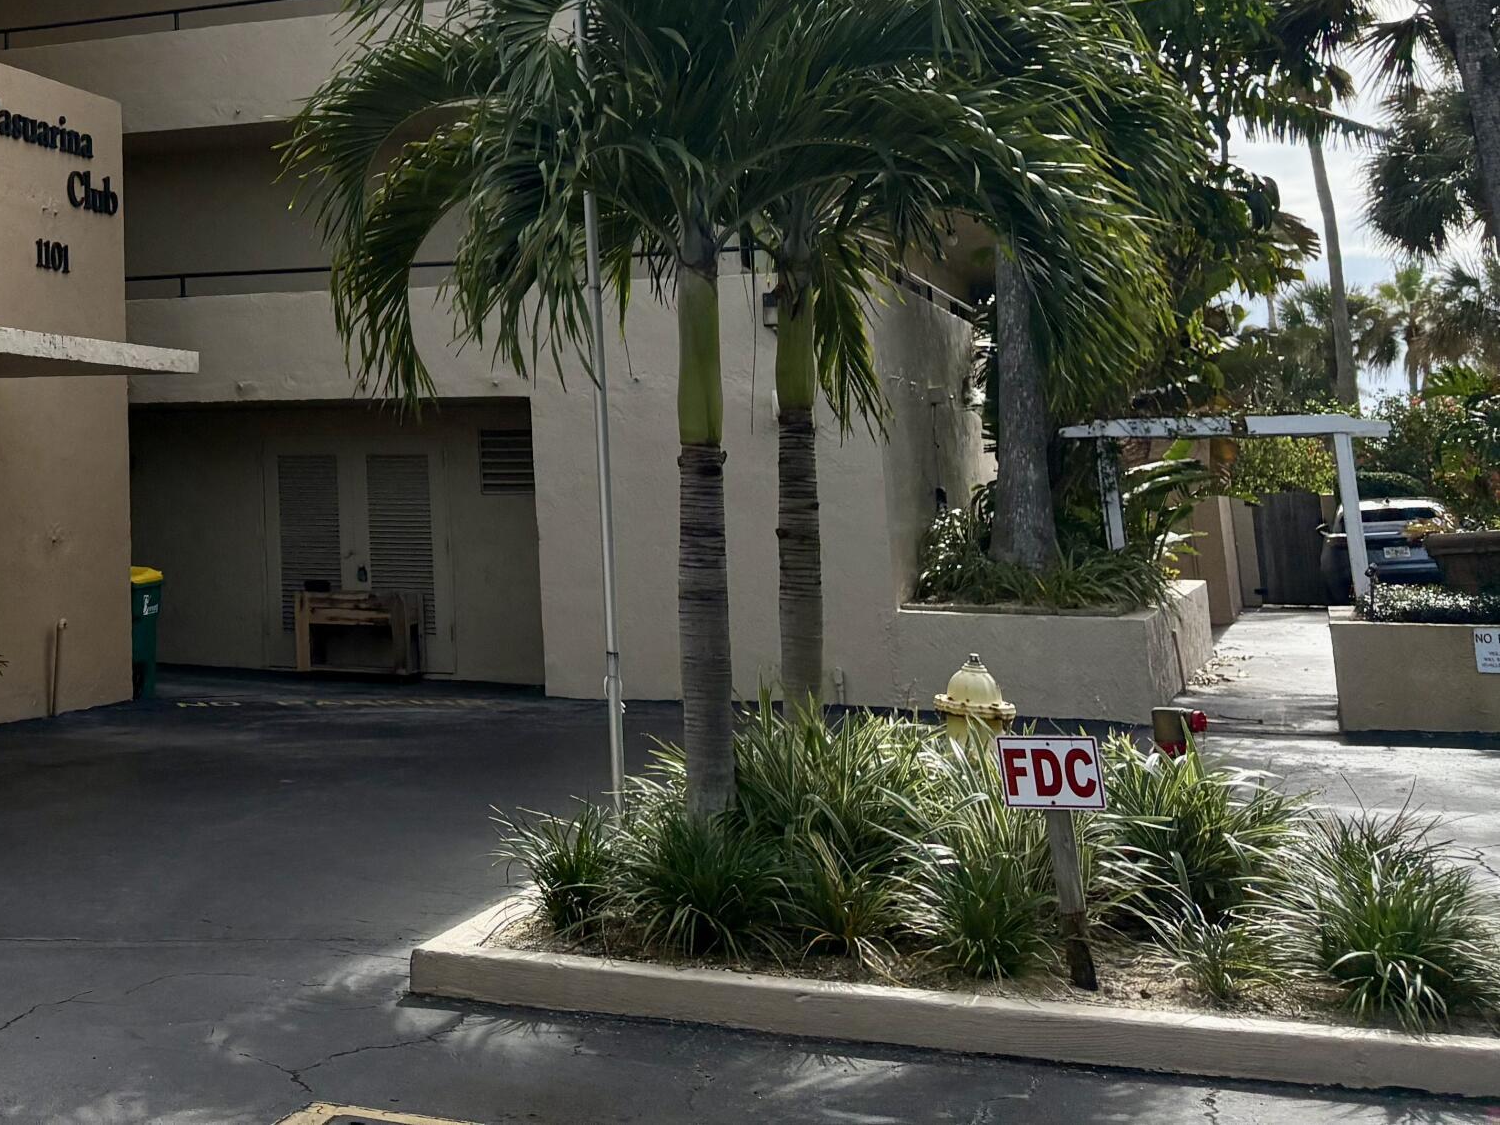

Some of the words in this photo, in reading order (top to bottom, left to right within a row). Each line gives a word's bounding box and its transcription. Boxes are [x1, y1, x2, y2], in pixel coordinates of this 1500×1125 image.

[67, 170, 118, 216] Club
[35, 238, 70, 274] 1101
[1475, 633, 1492, 644] NO
[1002, 747, 1097, 798] FDC
